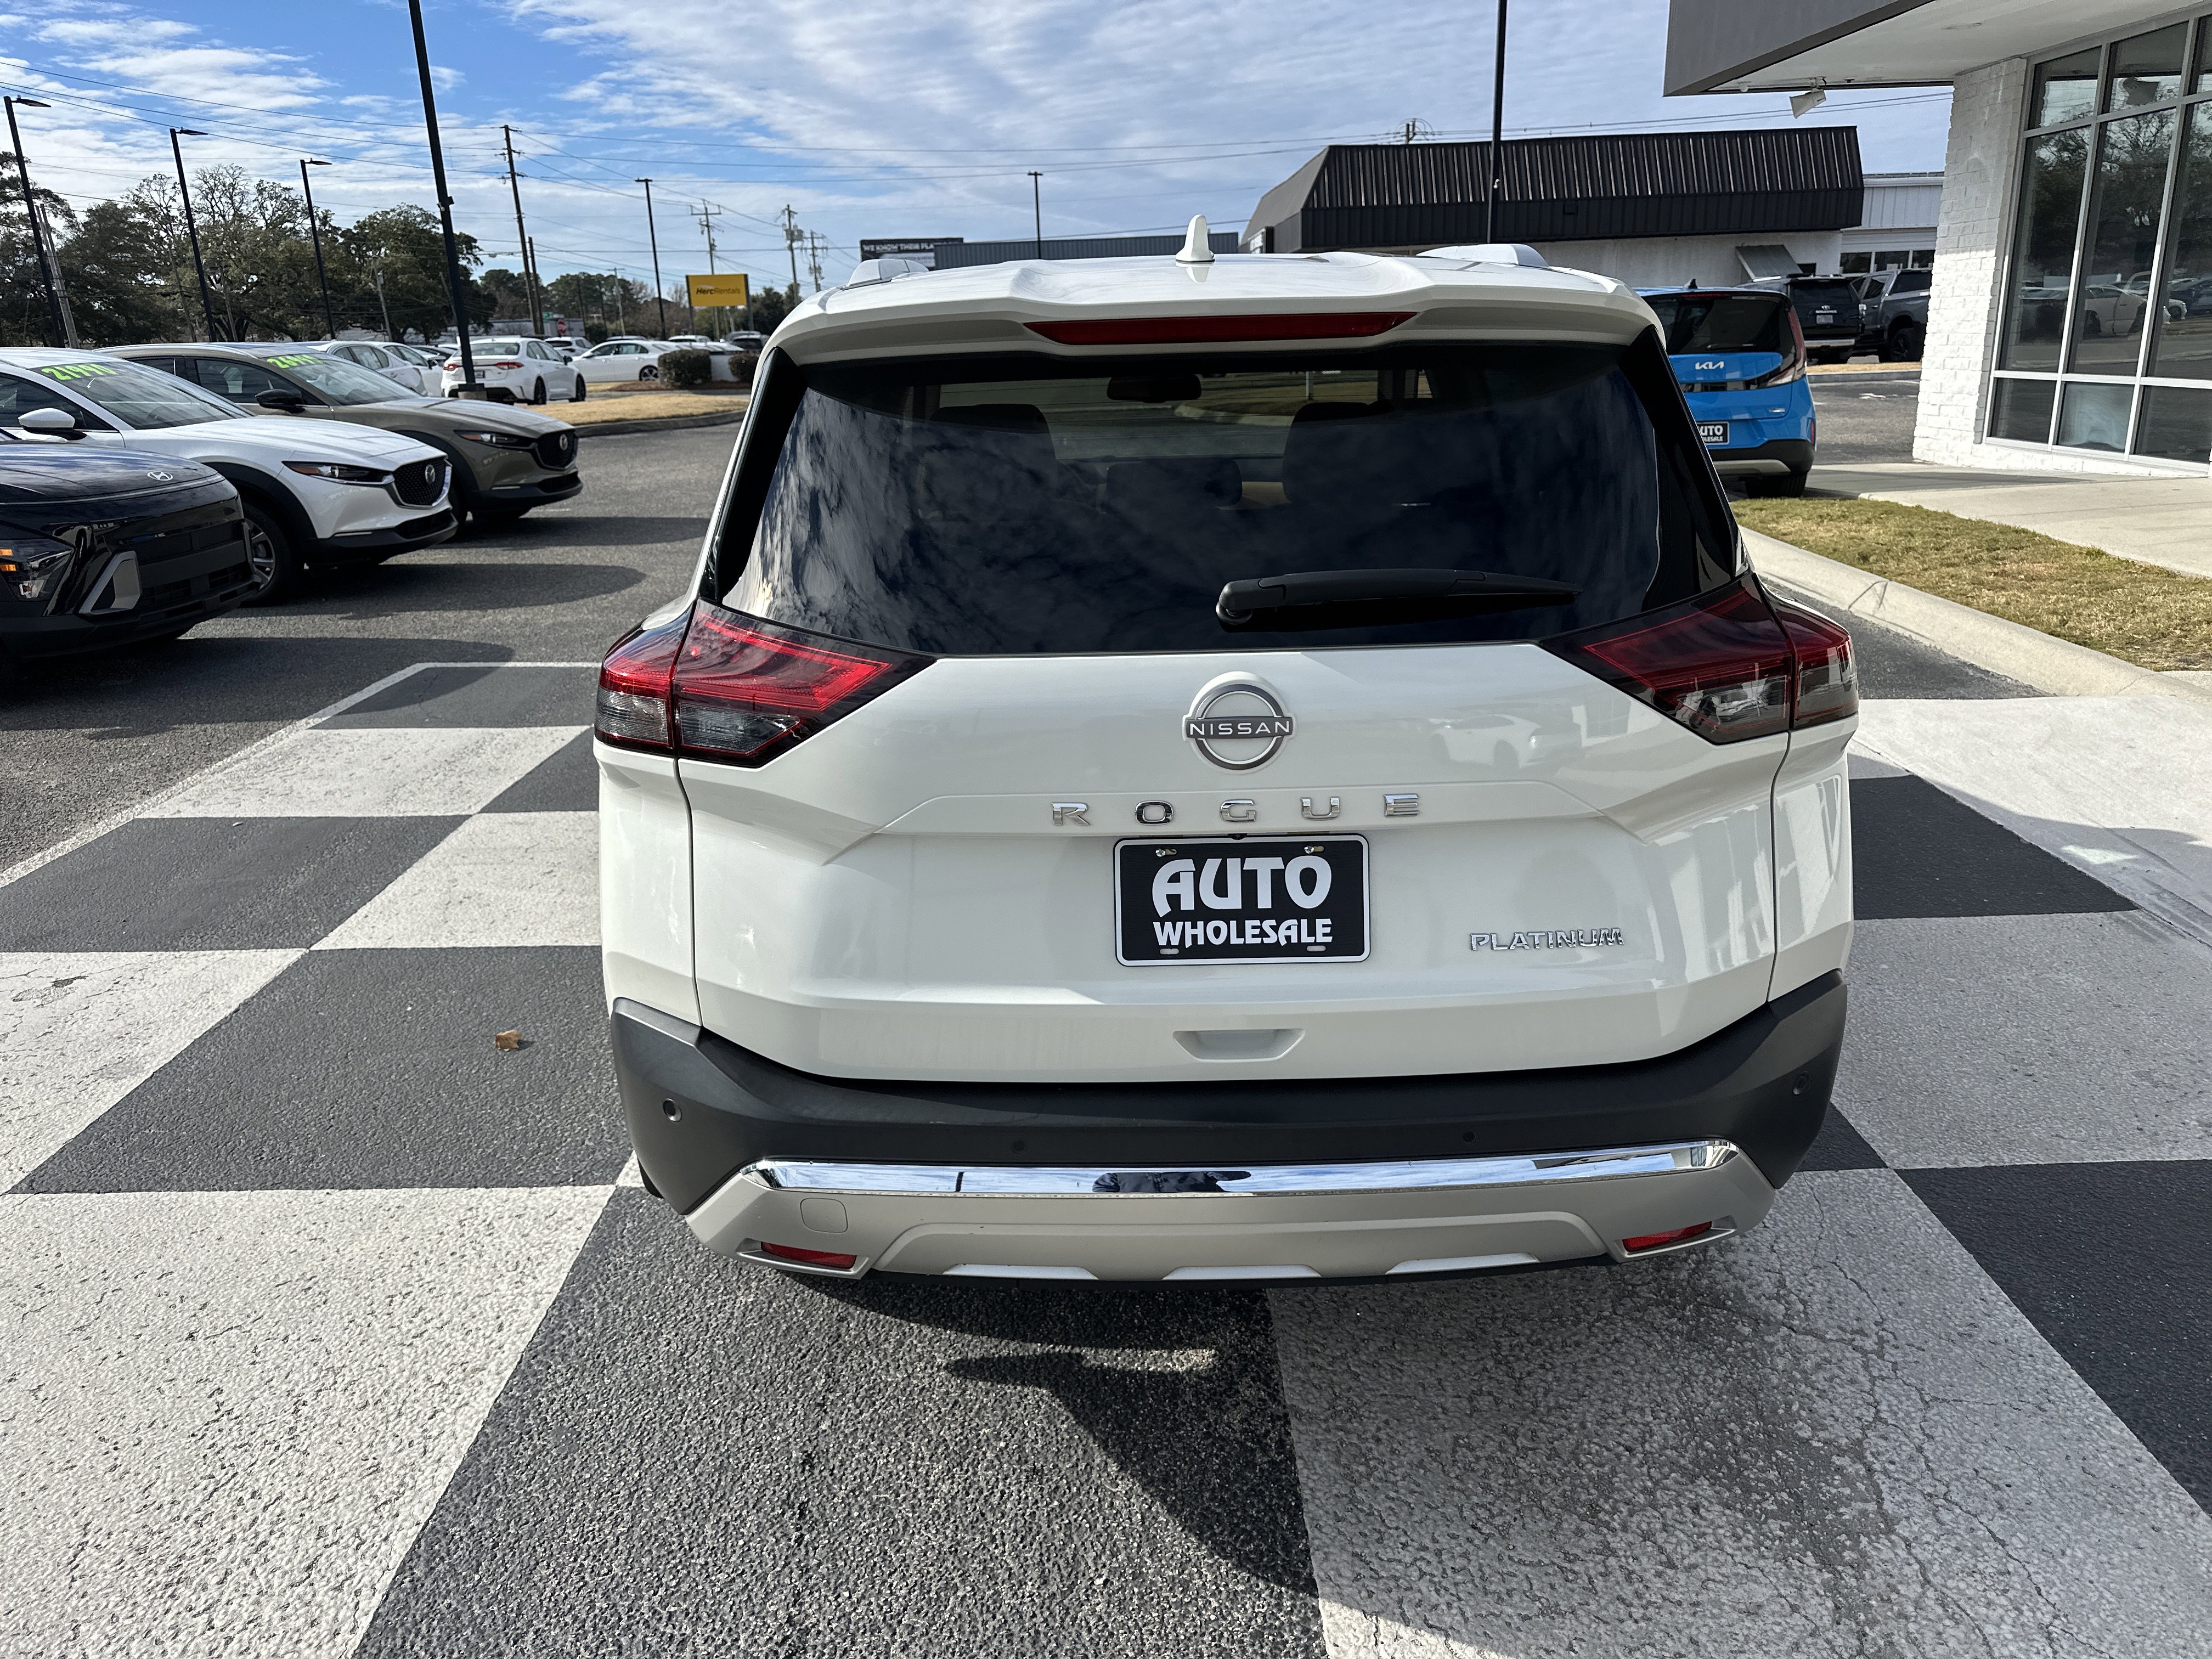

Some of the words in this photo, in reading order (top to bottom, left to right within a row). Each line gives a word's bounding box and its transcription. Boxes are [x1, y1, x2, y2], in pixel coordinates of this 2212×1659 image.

[41, 364, 117, 380] 21990
[1695, 361, 1724, 370] KIA
[1699, 425, 1723, 436] UTO
[1189, 720, 1289, 735] NISSAN
[1051, 793, 1420, 826] ROGUE
[1152, 855, 1332, 917] AUTO
[1153, 918, 1333, 948] WHOLESALE
[1470, 927, 1625, 951] PLATINUM
